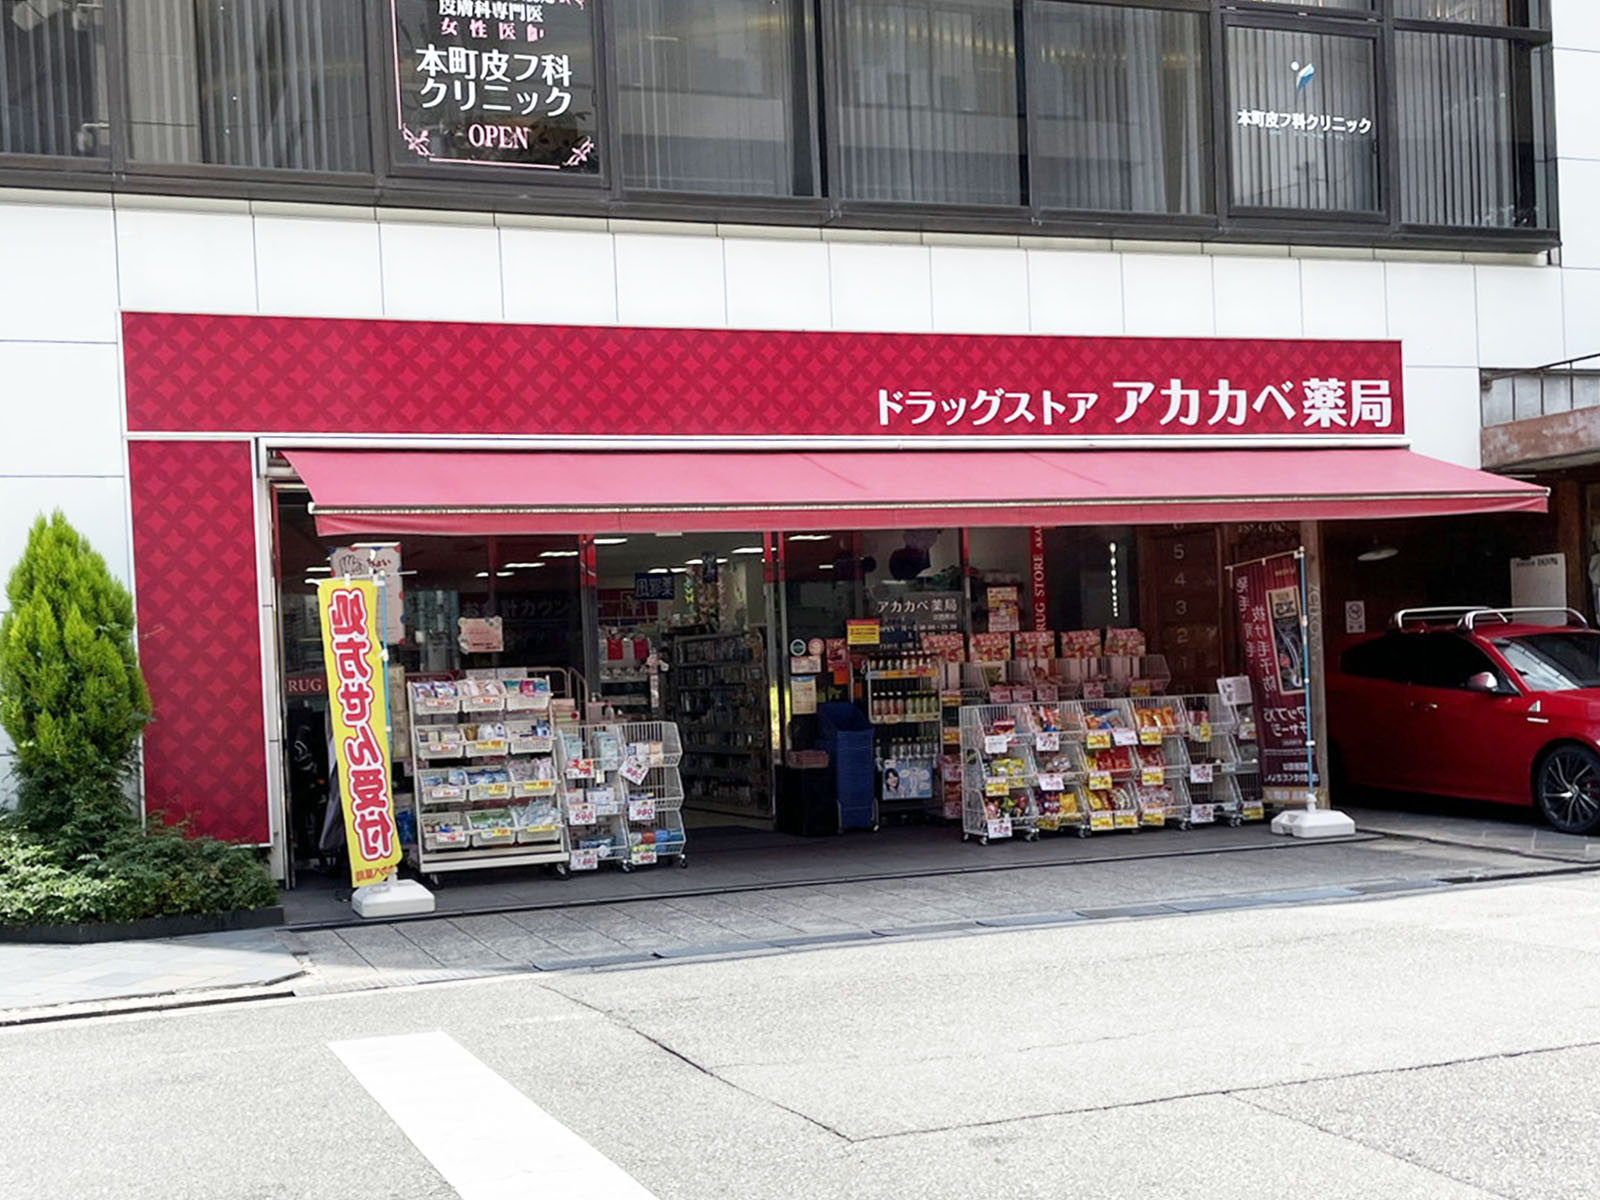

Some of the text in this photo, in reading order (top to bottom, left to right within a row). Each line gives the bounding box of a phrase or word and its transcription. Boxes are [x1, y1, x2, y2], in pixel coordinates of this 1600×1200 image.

[416, 44, 572, 87] 本町皮フ科
[420, 78, 572, 117] クリニック
[1237, 109, 1372, 134] 本町皮フ科クリニック
[468, 124, 531, 149] OPEN
[878, 378, 1393, 428] ドラッグストア アカカベ薬局
[1173, 544, 1185, 560] 5
[1174, 571, 1187, 587] 4
[1175, 600, 1188, 615] 3
